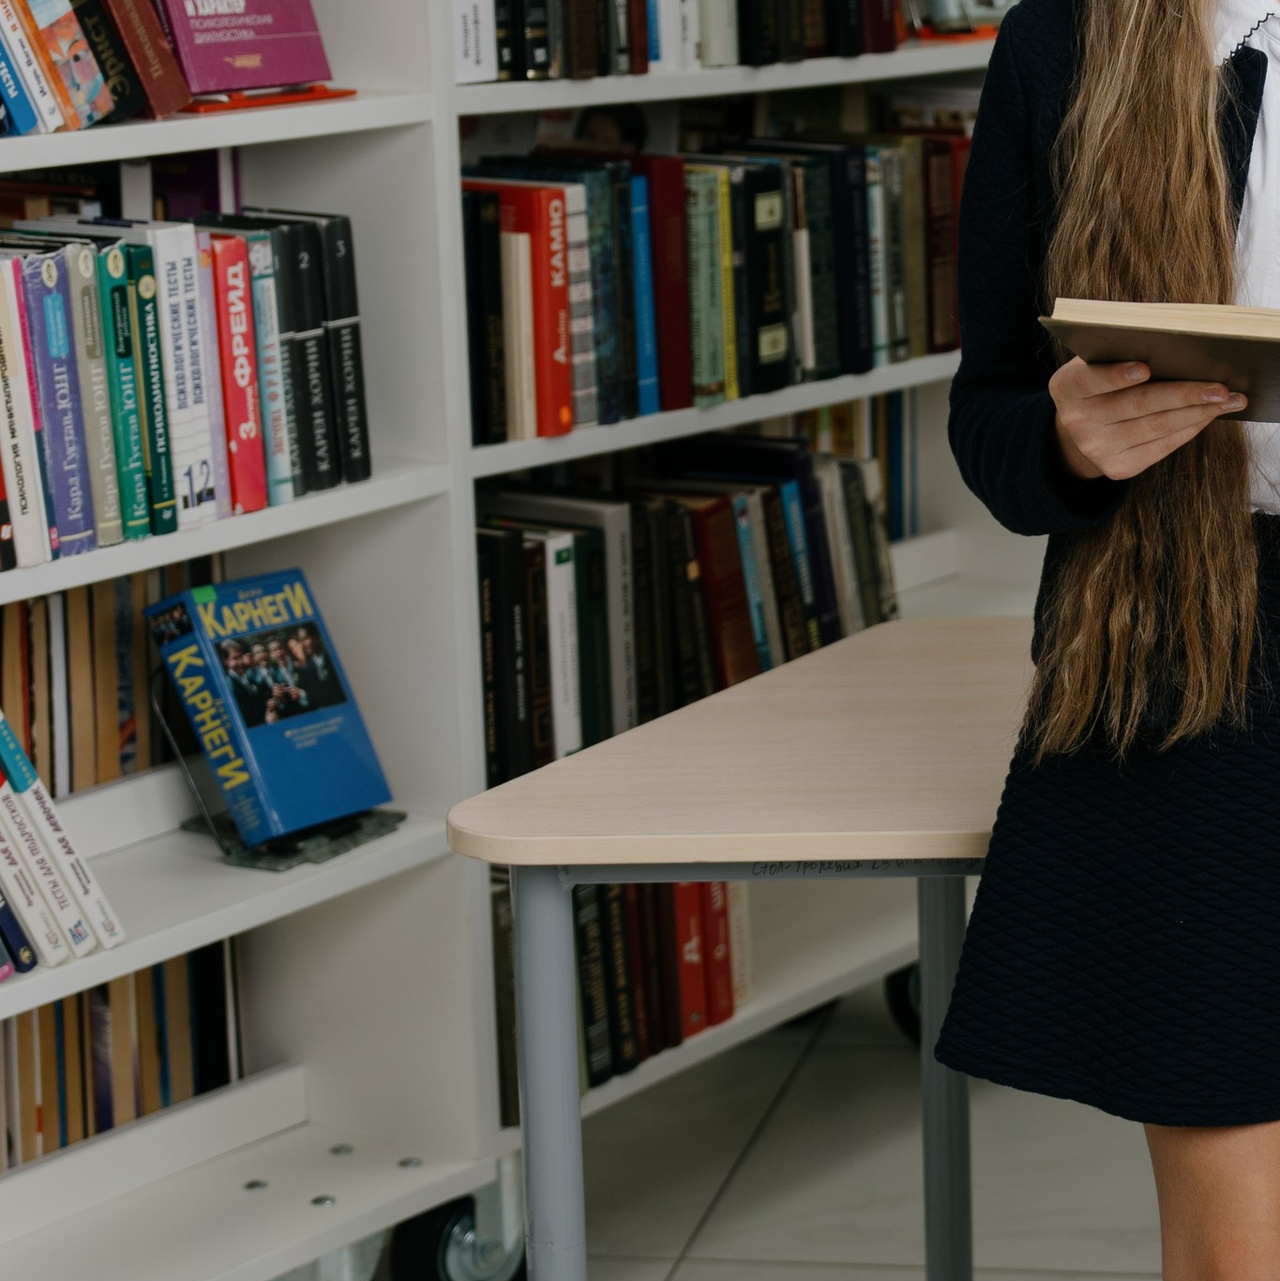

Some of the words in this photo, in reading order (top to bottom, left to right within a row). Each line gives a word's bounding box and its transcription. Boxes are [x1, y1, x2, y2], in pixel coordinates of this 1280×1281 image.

[184, 0, 195, 17] И
[16, 37, 35, 68] Вагин
[79, 11, 133, 102] Эрнст
[193, 29, 257, 44] ДИАГНОСТИКА
[29, 67, 49, 98] Игорь
[298, 250, 311, 271] 2
[334, 239, 346, 258] 3
[546, 199, 563, 288] КАМЮ
[167, 261, 179, 298] ТЕСТЫ
[183, 257, 195, 294] ТЕСТЫ
[226, 261, 251, 386] ФРЕЙД
[145, 302, 166, 453] ПСИХОДИАГНОСТИКА
[170, 301, 188, 409] ПСИХОЛОГИЧЕСКИЕ
[187, 299, 204, 404] ПСИХОЛОГИЧЕСКИЕ
[261, 343, 278, 402] ФРЕЙД
[304, 339, 324, 406] ХОРНИ
[338, 327, 357, 393] ХОРНИ
[53, 363, 70, 410] ЮНГ
[91, 363, 105, 411] ЮНГ
[120, 362, 136, 410] ЮНГ
[62, 415, 77, 471] Густав
[127, 414, 143, 468] Густав
[309, 410, 331, 472] КАРЕН
[343, 398, 363, 460] КАРЕН
[11, 443, 30, 515] ПСИХОЛОГИЯ
[67, 476, 84, 520] Карл
[132, 473, 146, 516] Карл
[198, 581, 314, 641] КАРНЕГИ
[166, 644, 251, 792] КАРНЕГИ
[0, 791, 42, 858] ПОДРОСТКОВ
[29, 784, 64, 836] ДЕВОЧЕК
[35, 855, 55, 879] ДЛЯ
[56, 834, 76, 859] ДЛЯ
[46, 877, 72, 911] ТЕСТЫ
